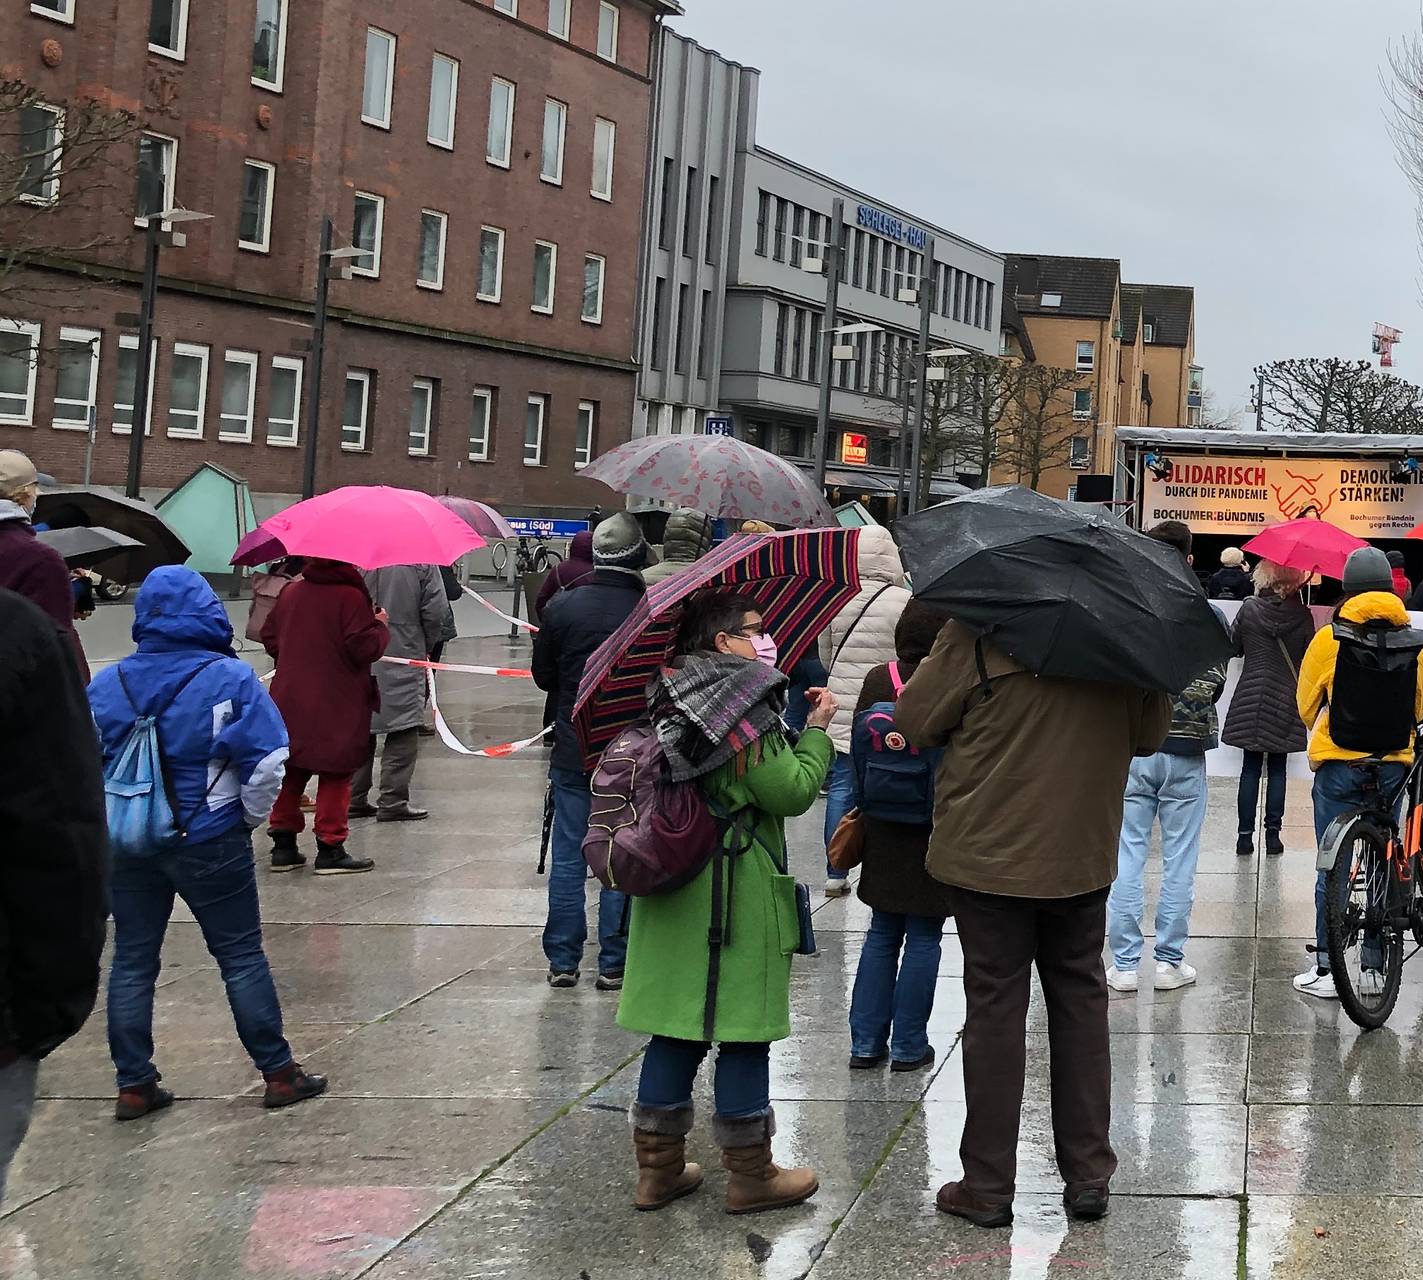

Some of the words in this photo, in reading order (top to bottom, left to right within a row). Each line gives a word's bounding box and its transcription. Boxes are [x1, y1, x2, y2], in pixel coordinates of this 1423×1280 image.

[1152, 464, 1266, 486] OLIDARISCH
[1165, 486, 1198, 498] DURCH
[1201, 487, 1216, 498] DIE
[1220, 488, 1268, 500] PANDEMIE
[1340, 484, 1404, 502] STÄRKEN!
[529, 520, 554, 531] (Süd)
